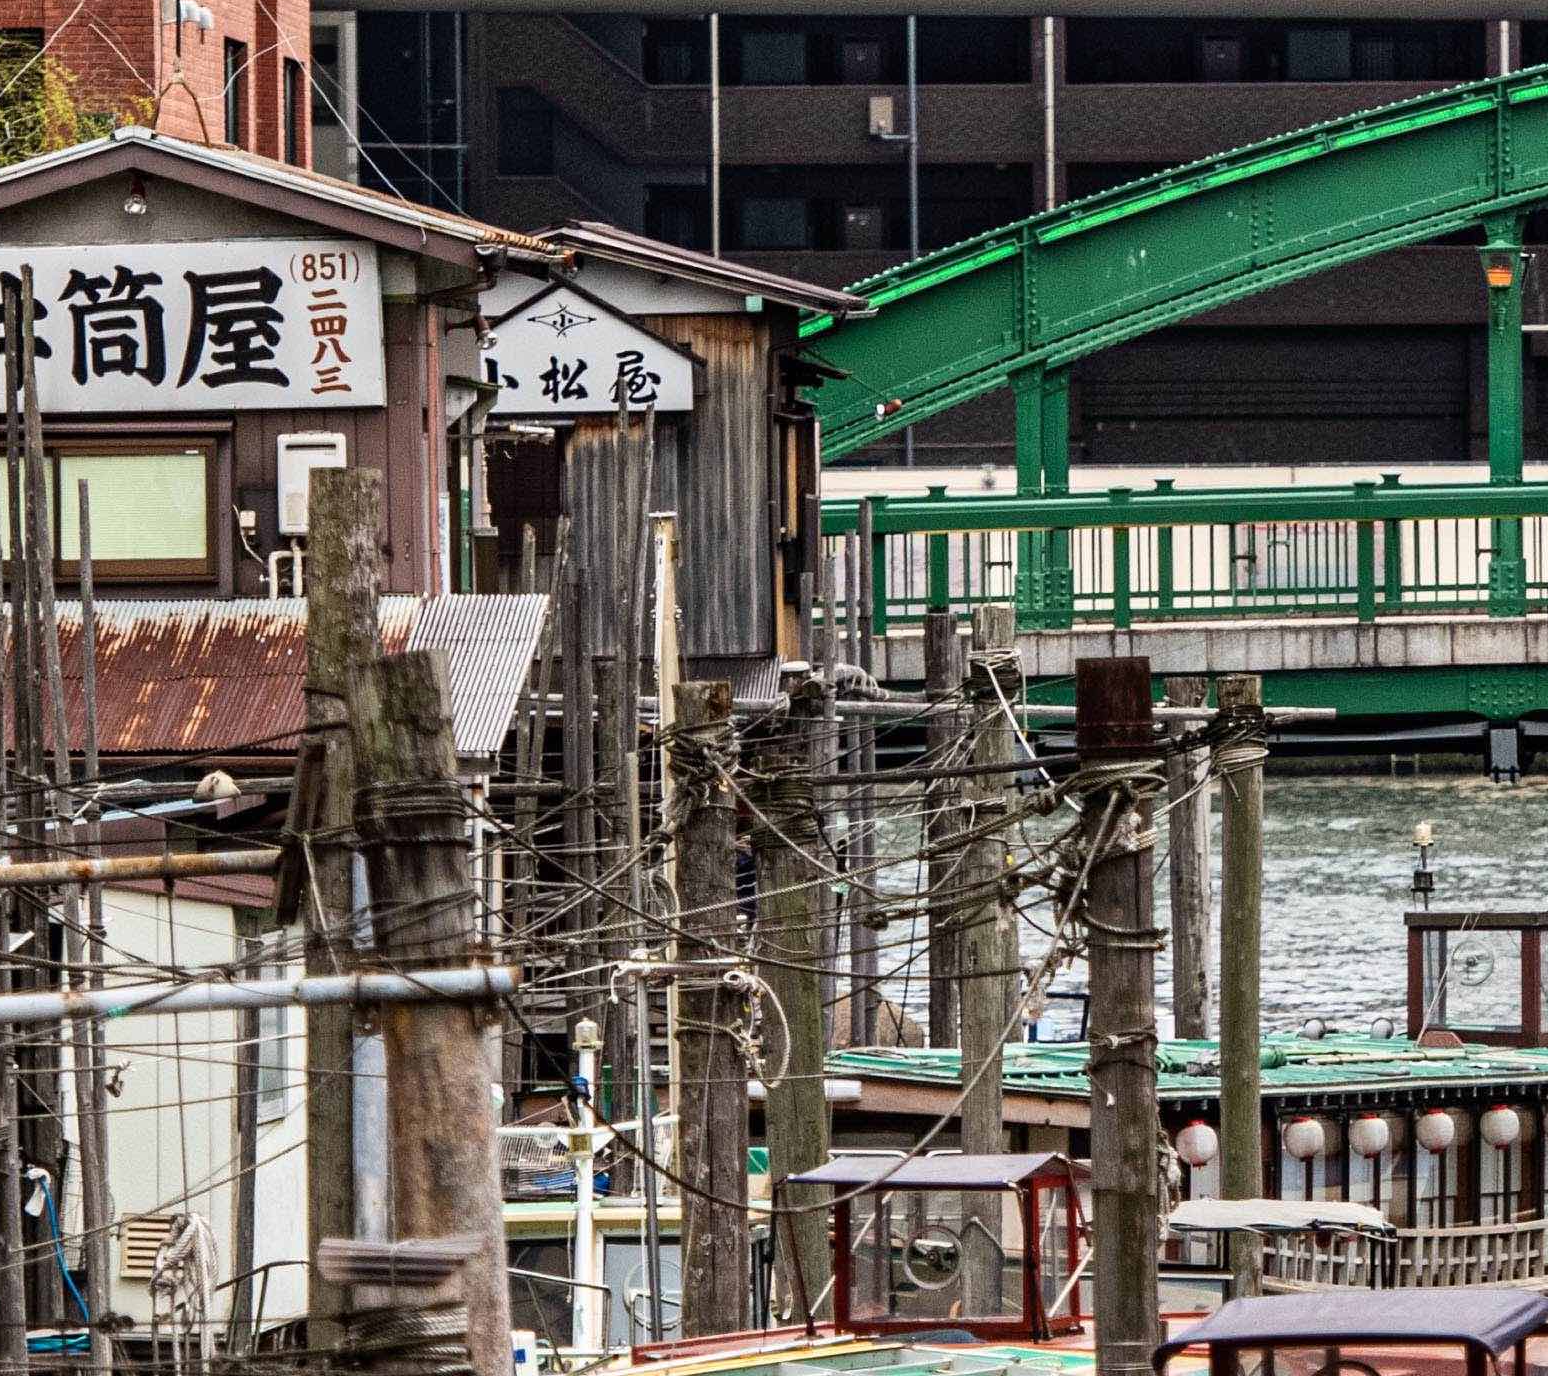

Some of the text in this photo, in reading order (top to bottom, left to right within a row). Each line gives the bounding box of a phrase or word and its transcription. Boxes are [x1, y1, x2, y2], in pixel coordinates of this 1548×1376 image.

[288, 251, 361, 283] (851)
[306, 288, 352, 395] 二四八三
[484, 350, 662, 405] 小松屋
